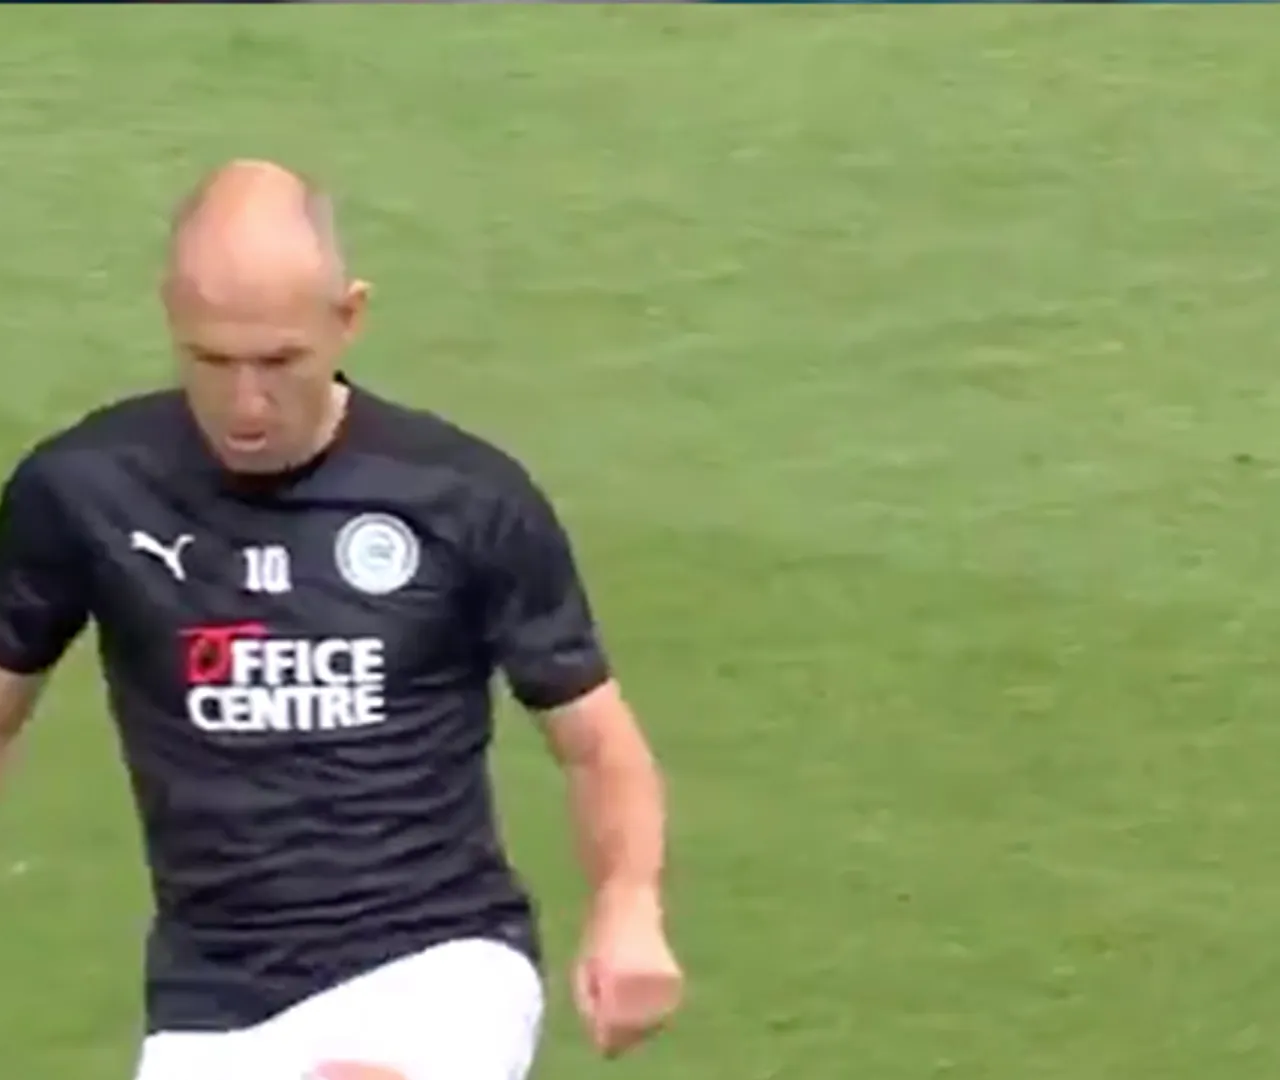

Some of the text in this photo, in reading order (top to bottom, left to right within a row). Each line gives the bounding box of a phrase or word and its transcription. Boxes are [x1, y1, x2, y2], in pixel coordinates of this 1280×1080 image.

[243, 545, 291, 593] 10
[180, 622, 386, 685] OFFICE
[186, 684, 386, 731] CENTRE
